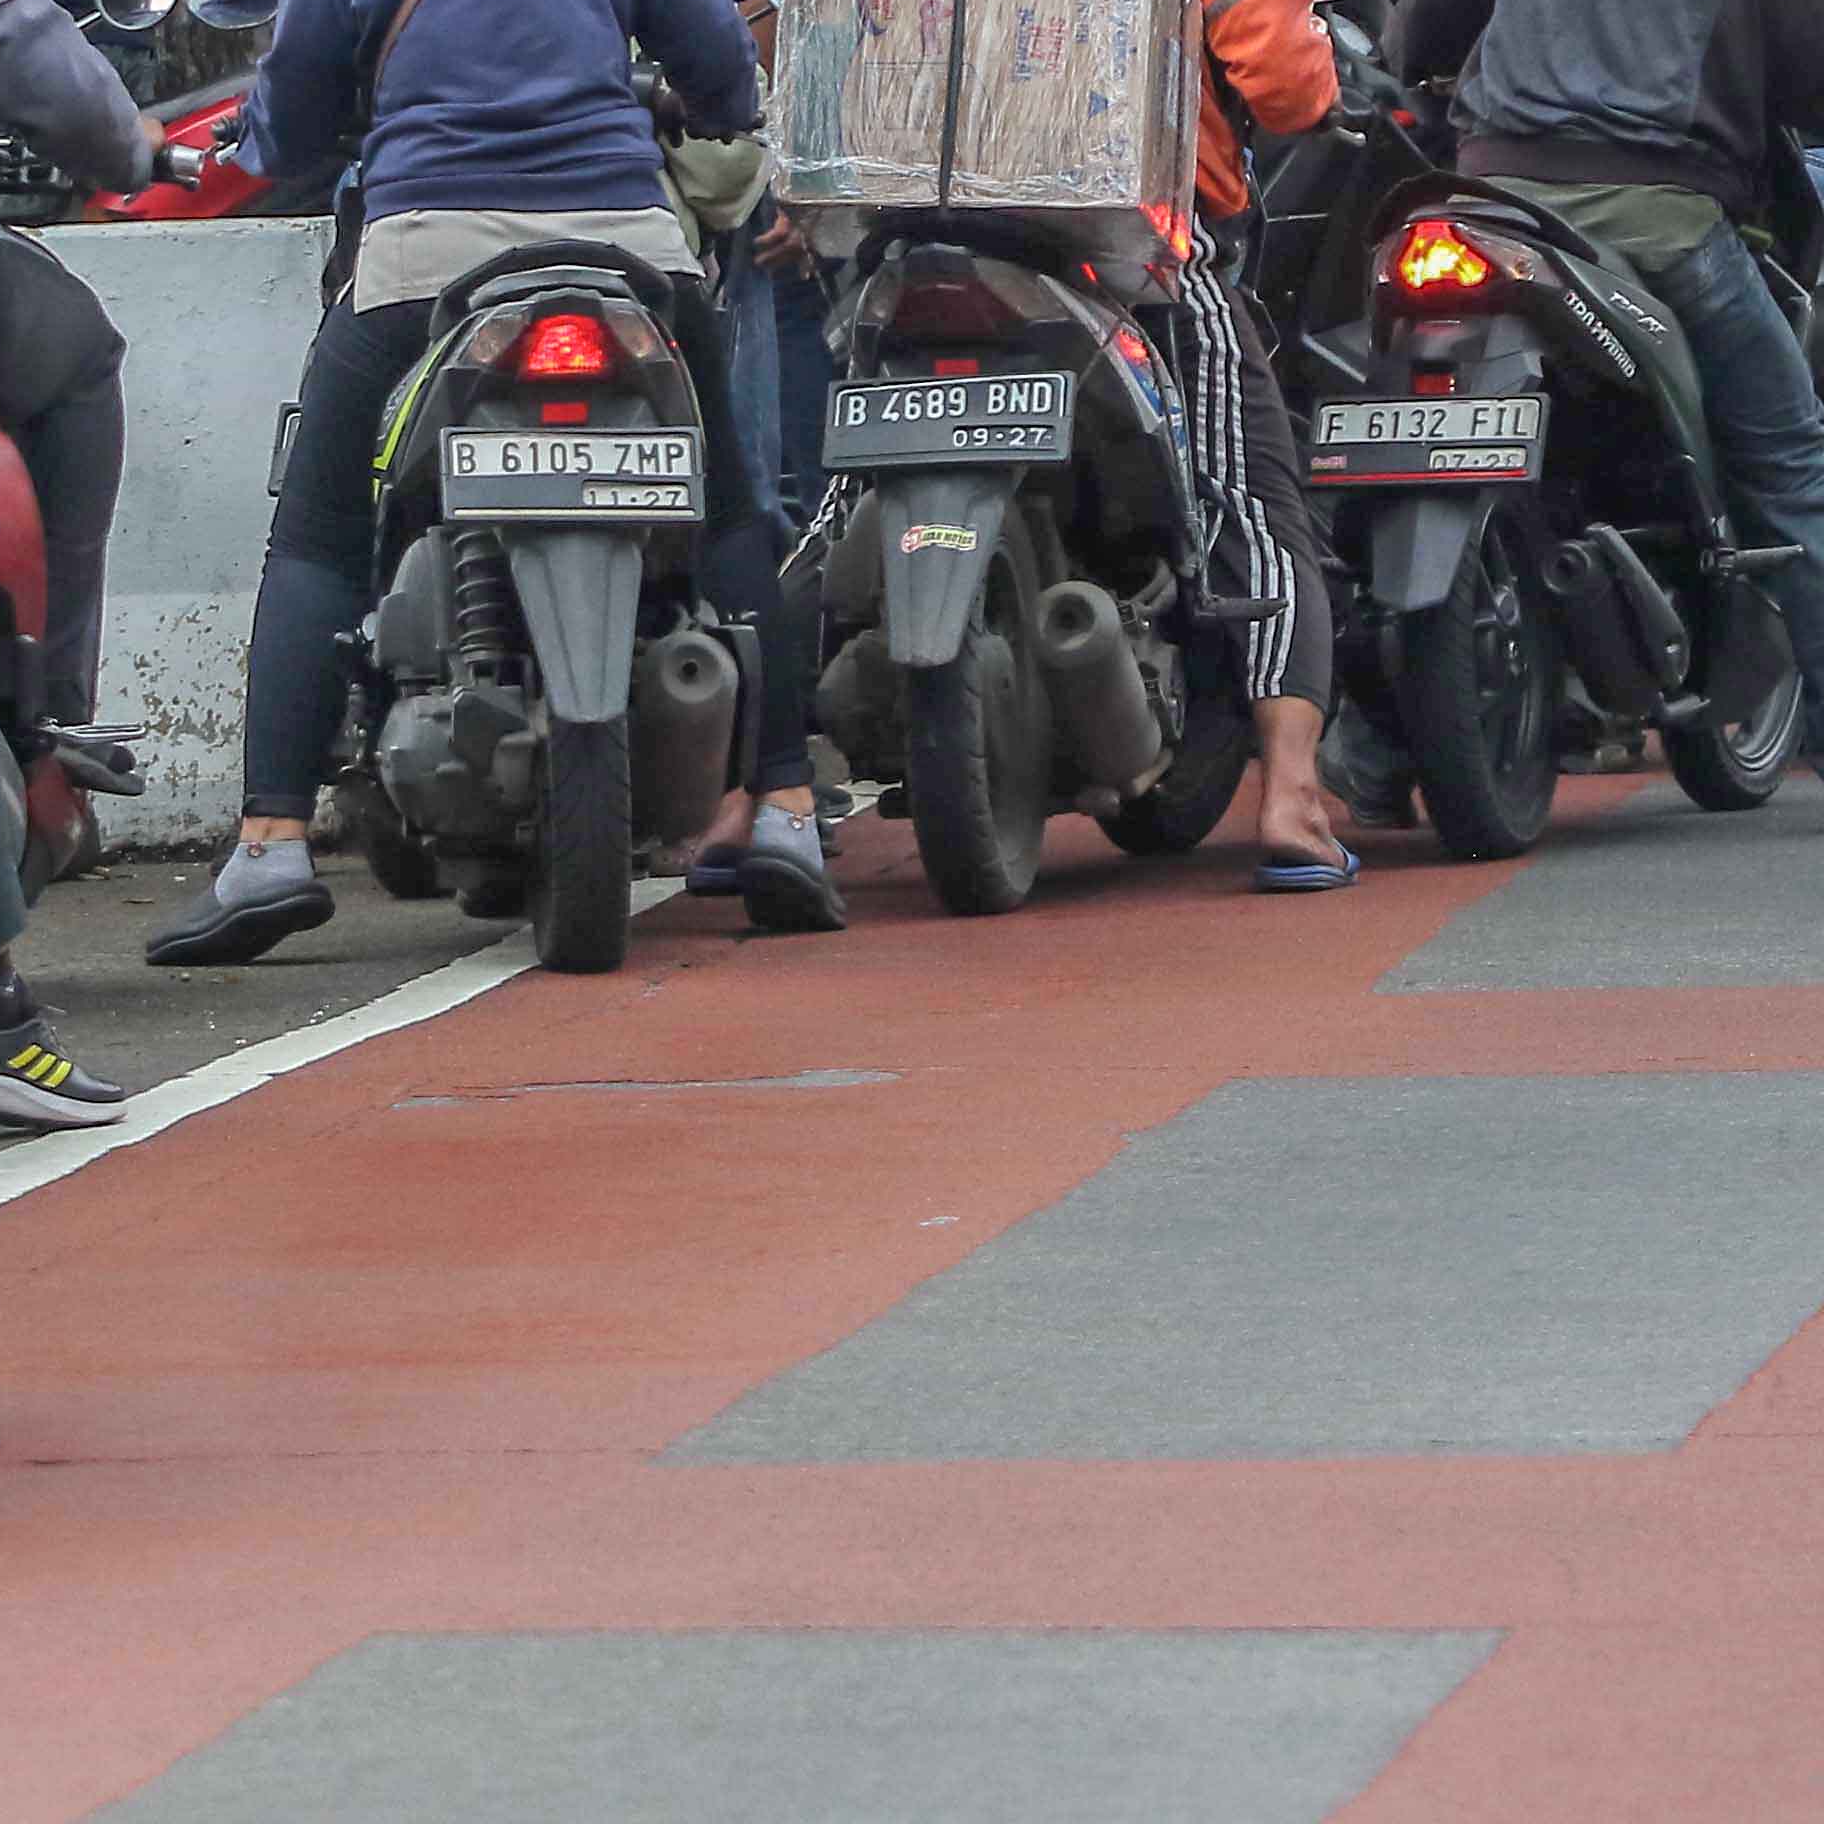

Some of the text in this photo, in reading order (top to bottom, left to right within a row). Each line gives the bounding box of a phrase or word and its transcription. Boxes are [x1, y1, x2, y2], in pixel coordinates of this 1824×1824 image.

[846, 382, 1053, 426] B 4689 BND
[1328, 407, 1529, 441] F 6132 FIL
[457, 442, 685, 475] B 6105 ZMP
